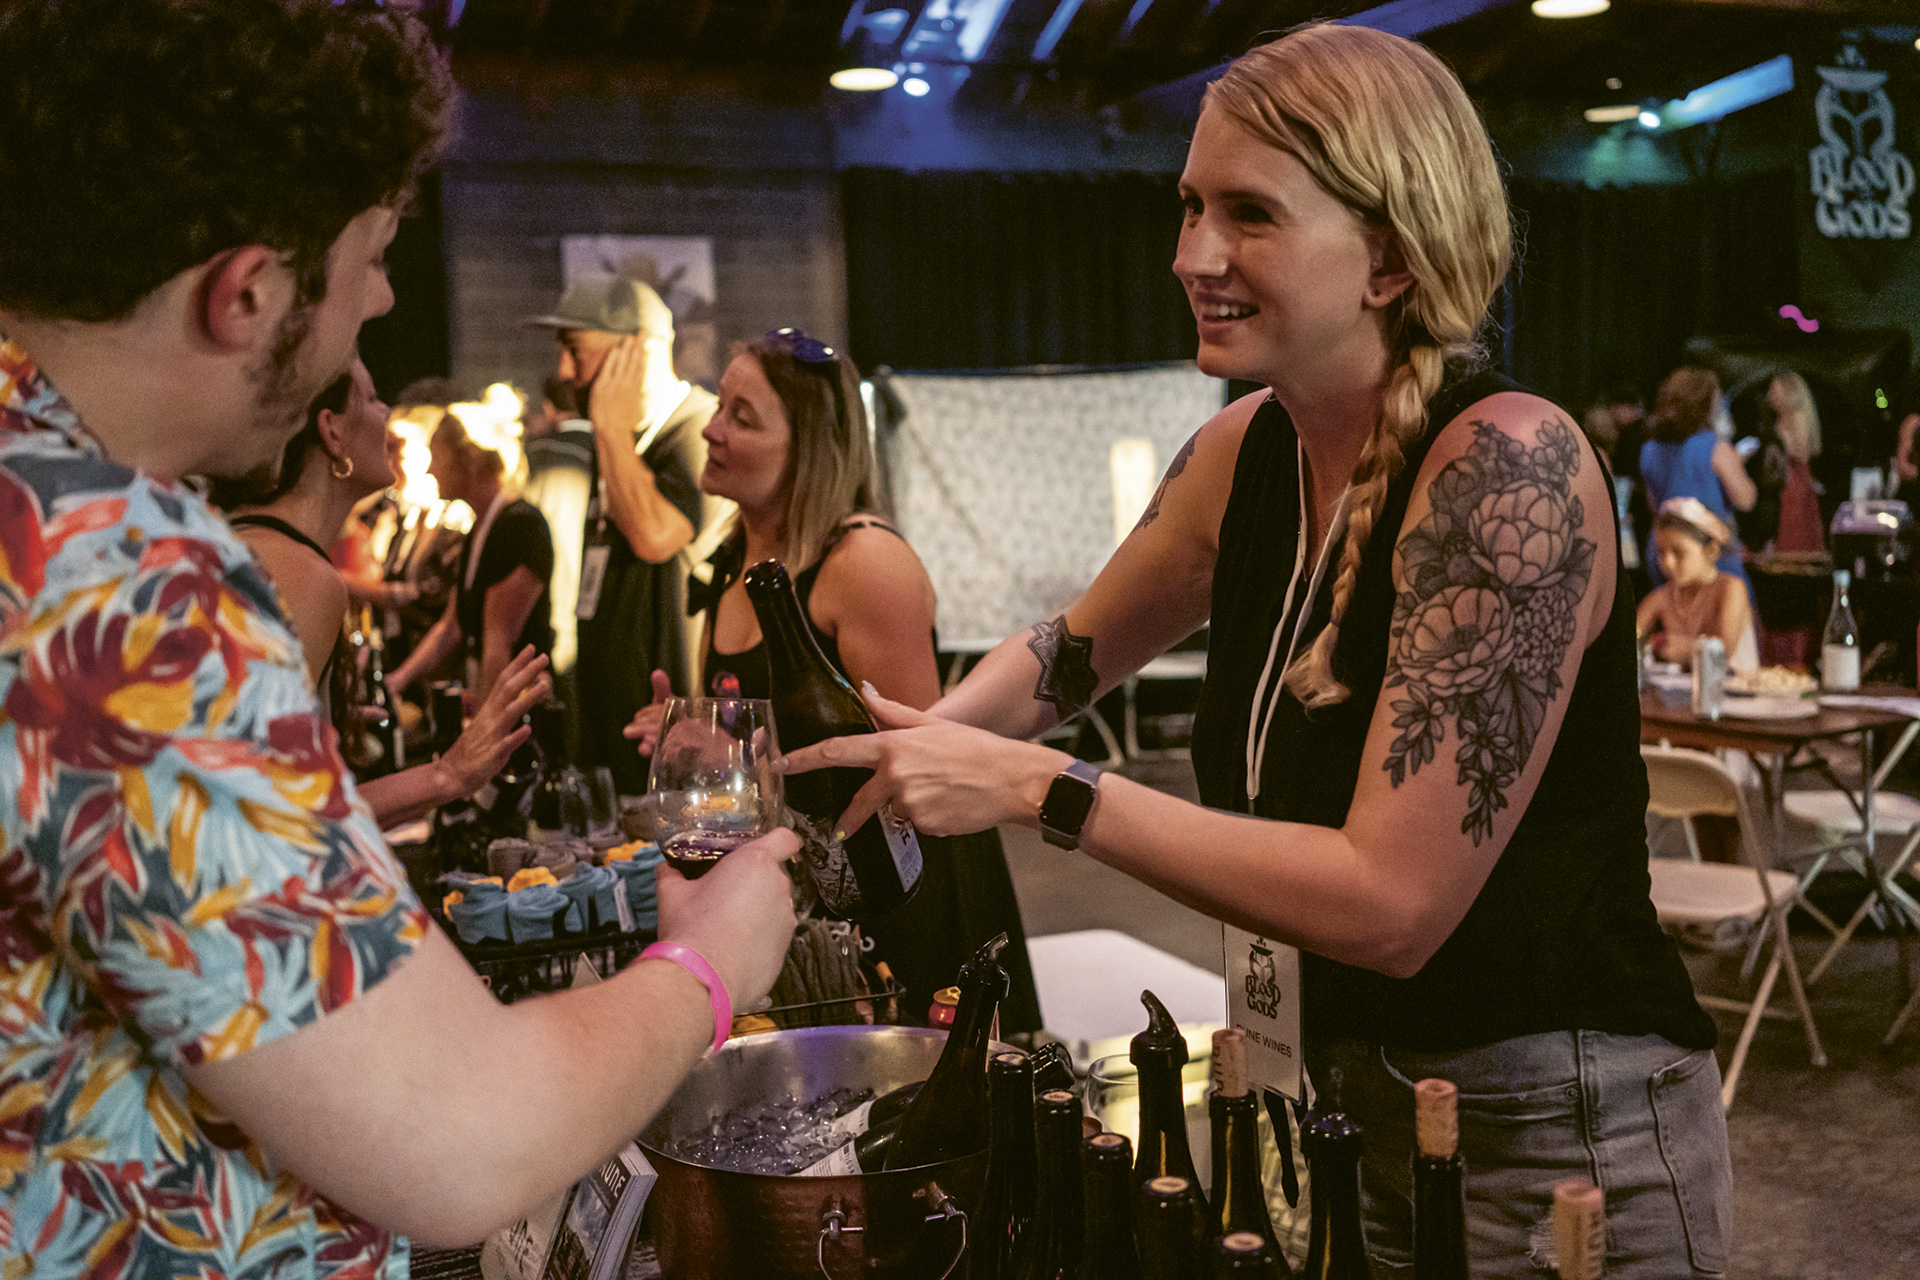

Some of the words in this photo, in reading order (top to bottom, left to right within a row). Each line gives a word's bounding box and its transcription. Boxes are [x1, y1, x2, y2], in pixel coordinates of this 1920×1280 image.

[1815, 198, 1912, 239] GODS
[1245, 975, 1281, 1007] BLOOD
[1247, 992, 1278, 1019] GODS
[1262, 1034, 1292, 1058] WINES
